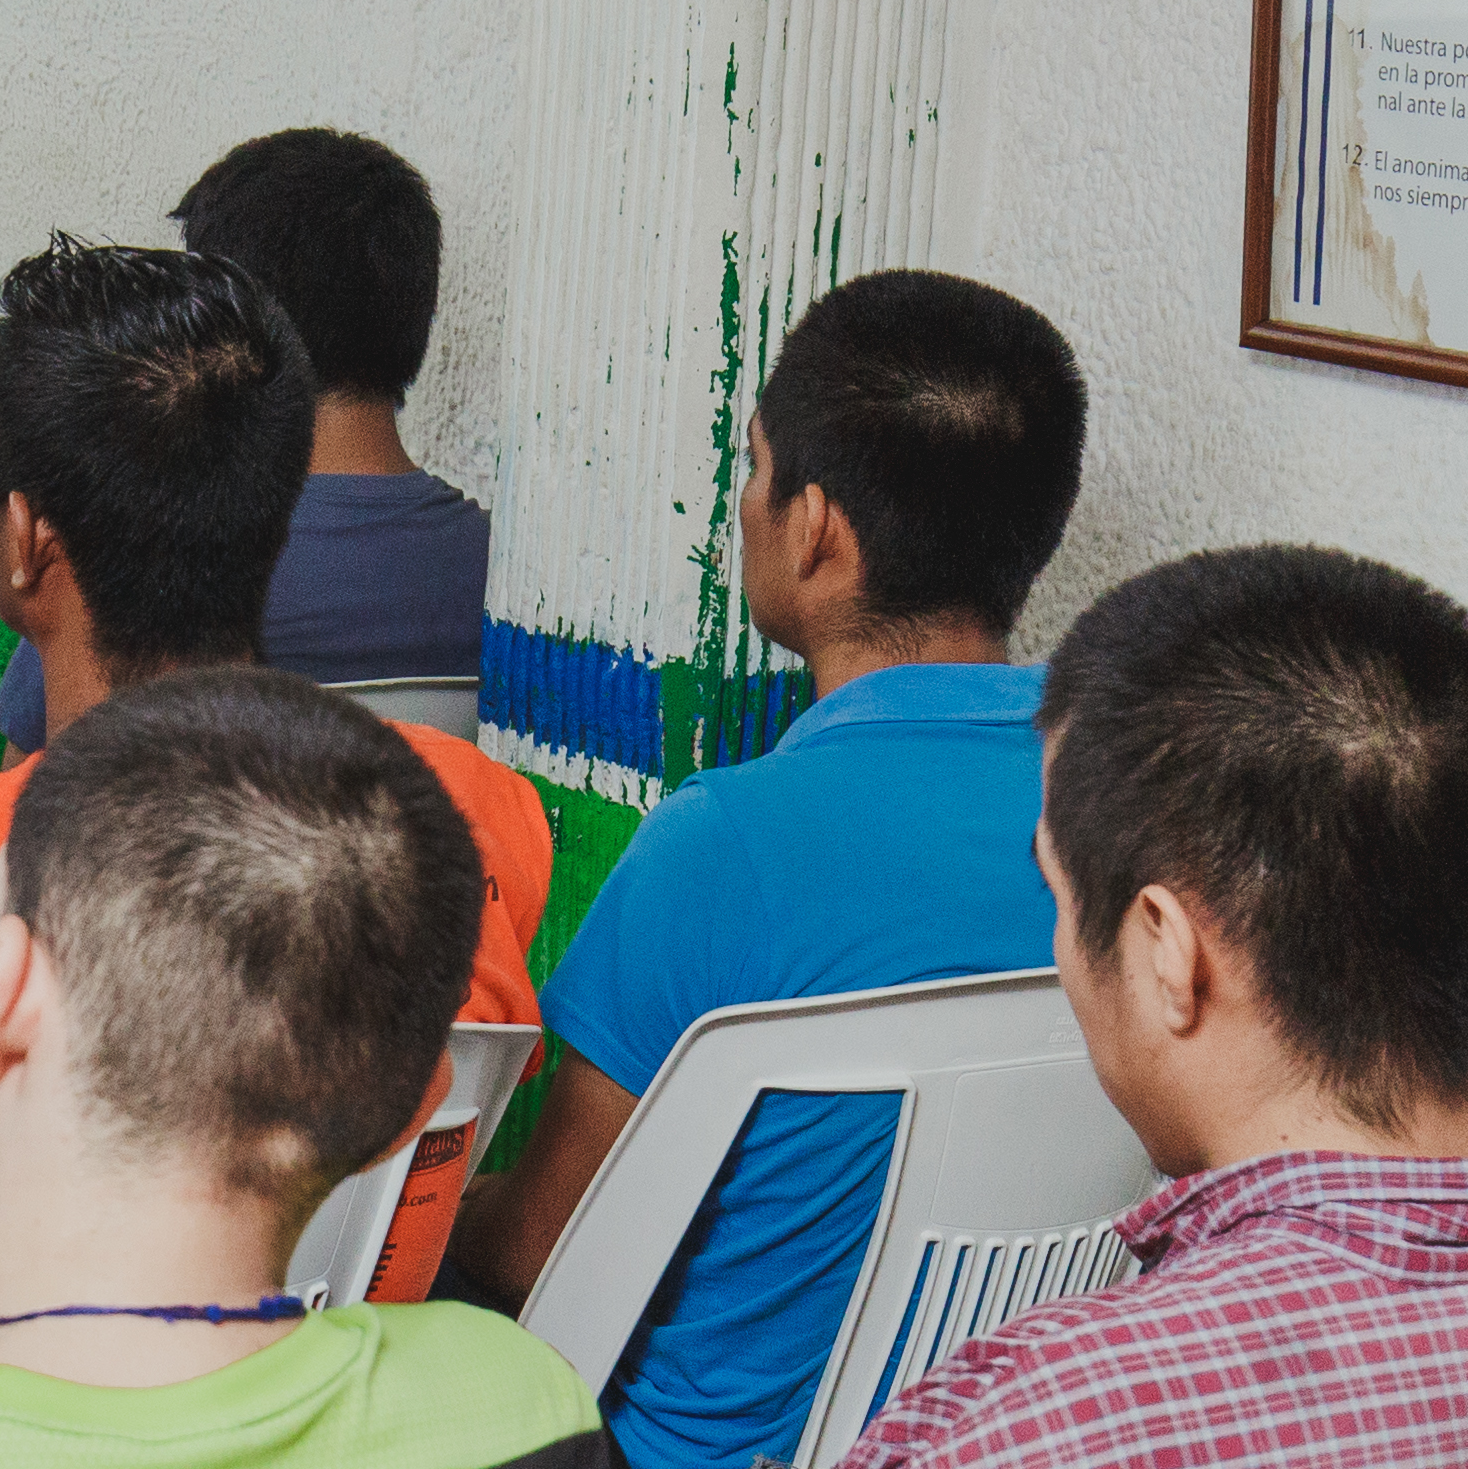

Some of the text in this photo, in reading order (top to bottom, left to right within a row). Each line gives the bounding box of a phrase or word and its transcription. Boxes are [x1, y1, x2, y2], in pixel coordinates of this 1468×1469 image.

[1348, 28, 1373, 50] 11.
[1381, 32, 1447, 58] Nuestra
[1378, 65, 1399, 82] en
[1404, 63, 1418, 84] la
[1378, 91, 1466, 120] nal ante la
[1343, 143, 1368, 166] 12.
[1375, 150, 1388, 172] El
[1374, 183, 1402, 203] nos
